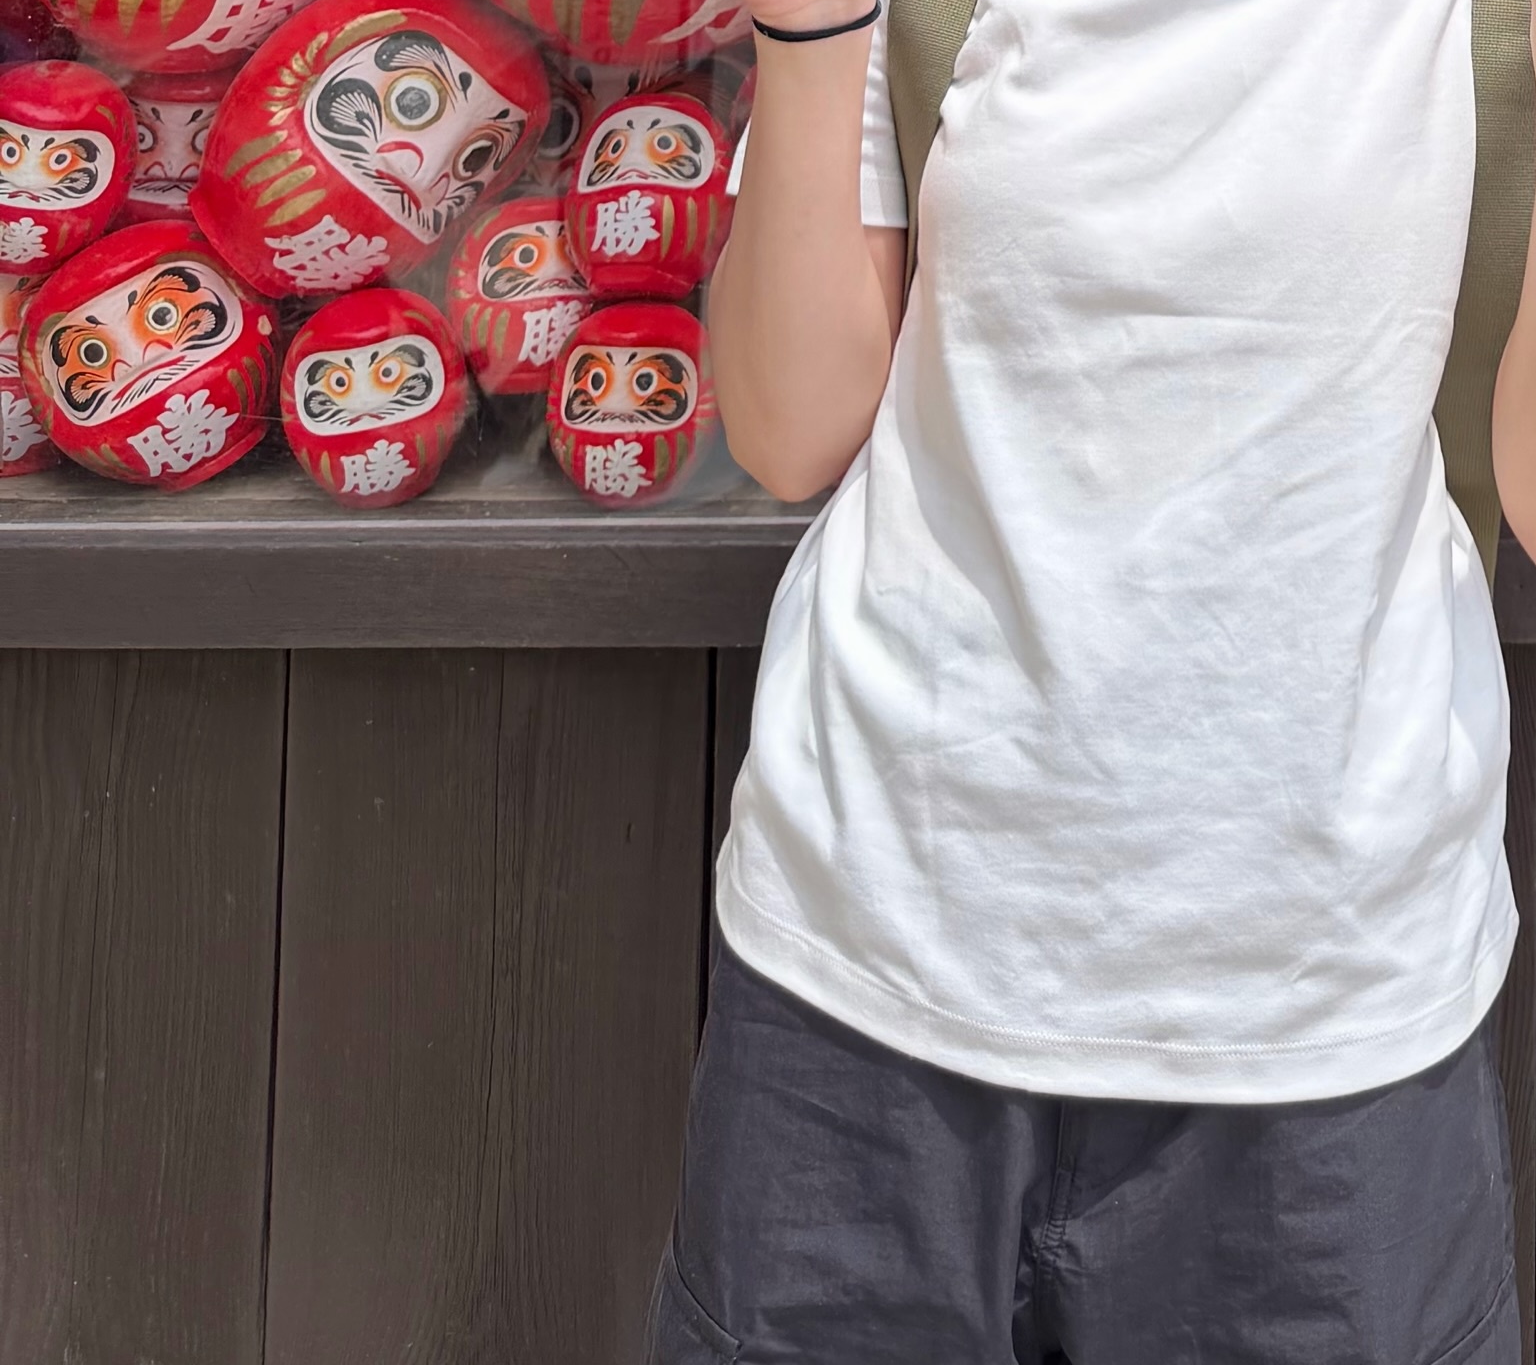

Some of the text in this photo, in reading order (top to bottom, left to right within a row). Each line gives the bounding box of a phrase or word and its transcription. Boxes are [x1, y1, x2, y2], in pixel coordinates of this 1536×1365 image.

[264, 214, 390, 291] 勝
[590, 189, 660, 258] 勝
[519, 299, 593, 366] 勝
[126, 387, 240, 478] 勝
[341, 439, 416, 497] 勝
[584, 437, 653, 499] 勝
